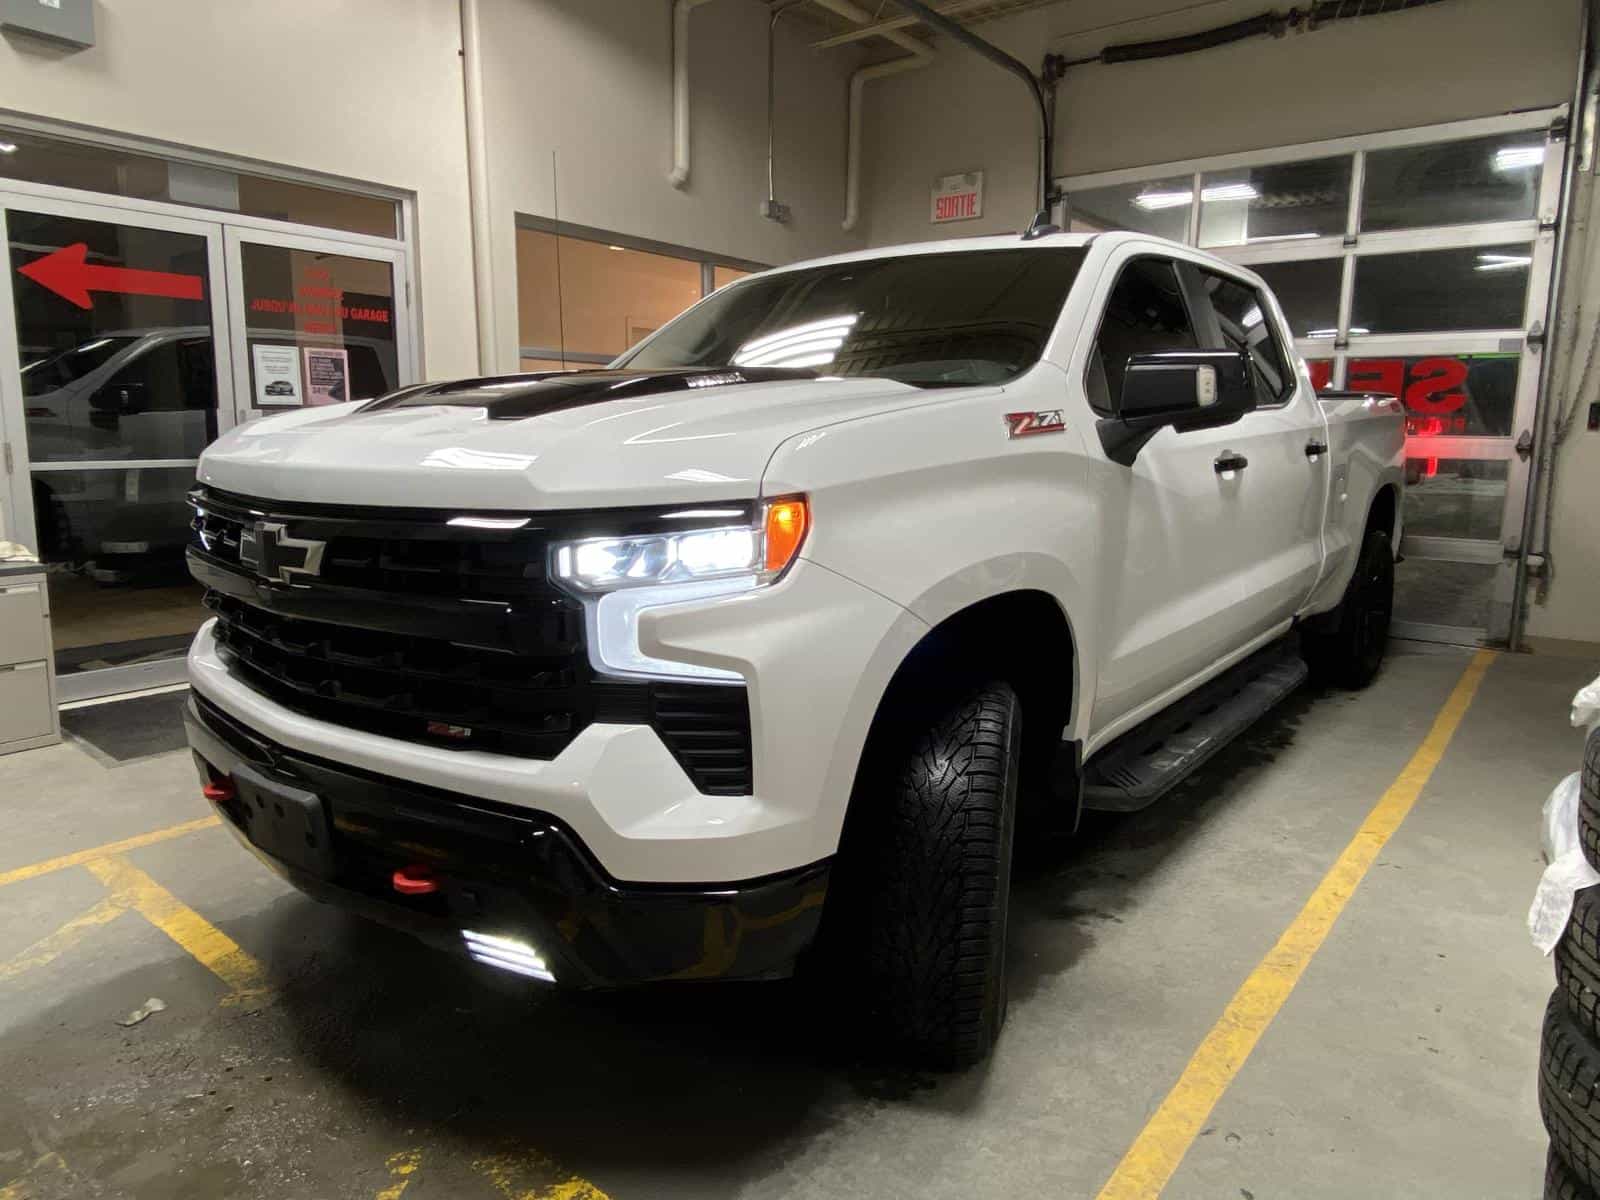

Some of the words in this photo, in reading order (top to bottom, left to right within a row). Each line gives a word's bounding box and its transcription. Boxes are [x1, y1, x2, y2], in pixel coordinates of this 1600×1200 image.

[935, 192, 977, 220] SORTIE
[350, 307, 389, 323] GARAGE
[1003, 409, 1065, 440] Z71
